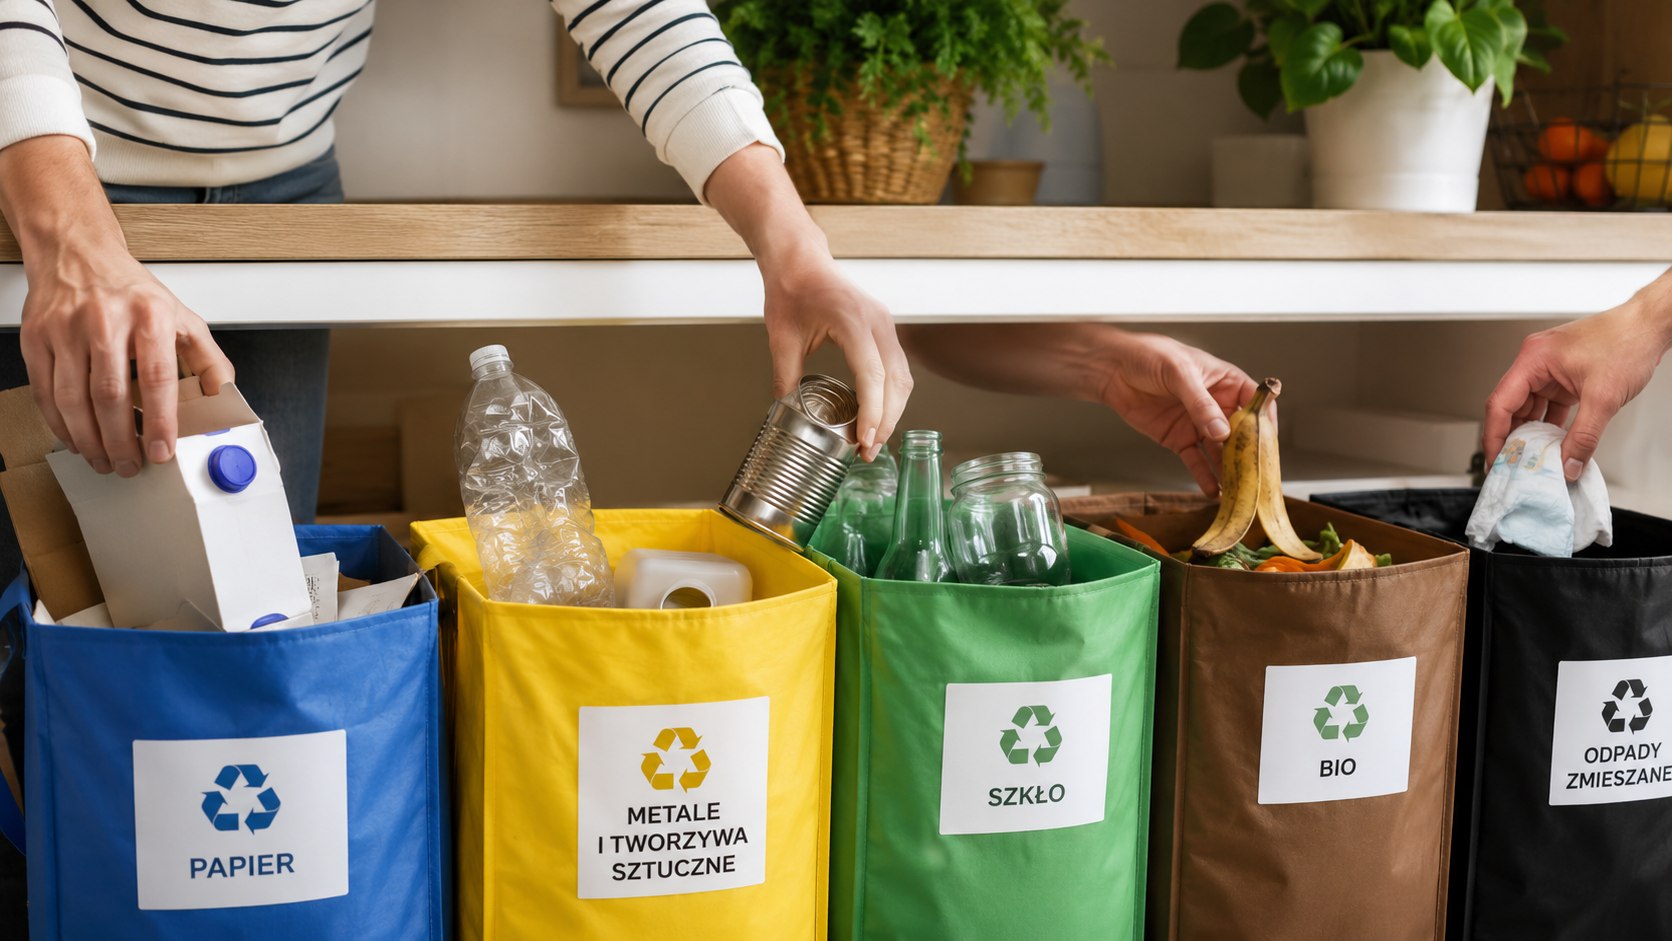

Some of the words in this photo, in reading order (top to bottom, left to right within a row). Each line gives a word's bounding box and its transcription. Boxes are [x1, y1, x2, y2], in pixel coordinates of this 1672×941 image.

[1584, 742, 1662, 764] ODPADY
[1319, 757, 1357, 778] BIO
[1565, 765, 1672, 790] ZMIESZANE
[987, 783, 1066, 807] SZKŁO
[627, 801, 721, 826] METALE
[598, 836, 604, 855] I
[609, 826, 749, 854] TWORZYWA
[189, 852, 295, 880] PAPIER
[611, 854, 736, 882] SZTUCZNE
